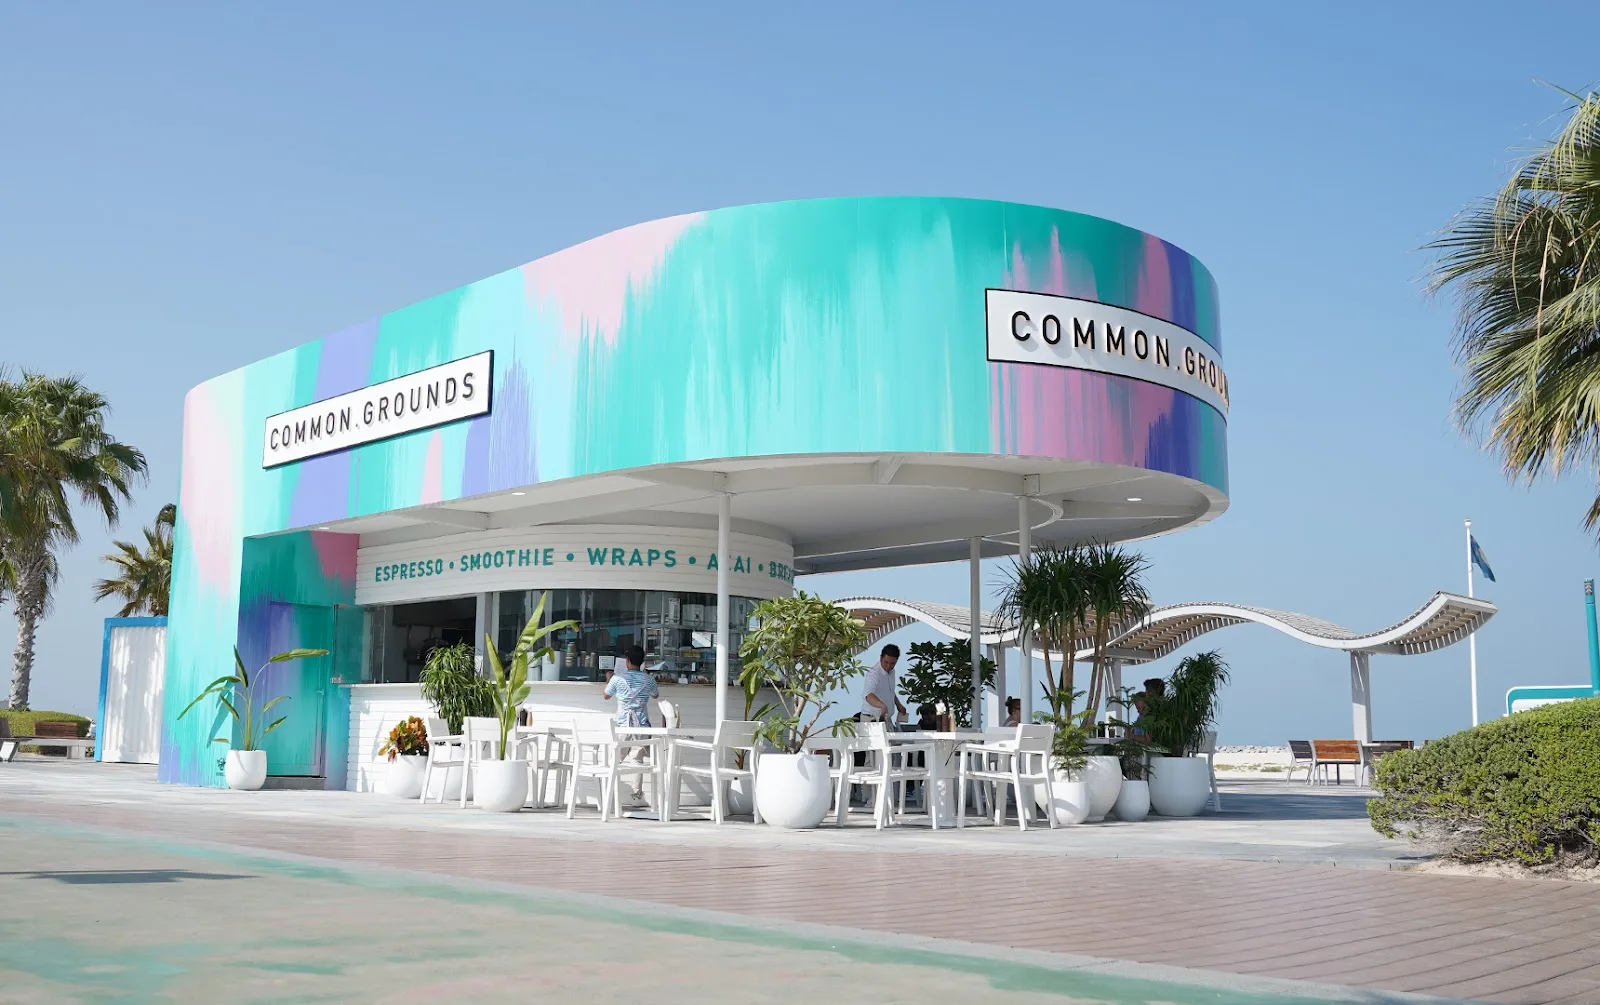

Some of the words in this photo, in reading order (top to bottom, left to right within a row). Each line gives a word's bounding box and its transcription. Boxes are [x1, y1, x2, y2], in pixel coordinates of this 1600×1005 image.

[1011, 310, 1229, 410] COMMON.GROUN
[270, 372, 475, 450] COMMON.GROUNDS
[375, 558, 443, 582] ESPRESSO
[460, 548, 554, 572] SMOOTHIE
[587, 547, 677, 568] WRAPS
[707, 553, 750, 573] AAI
